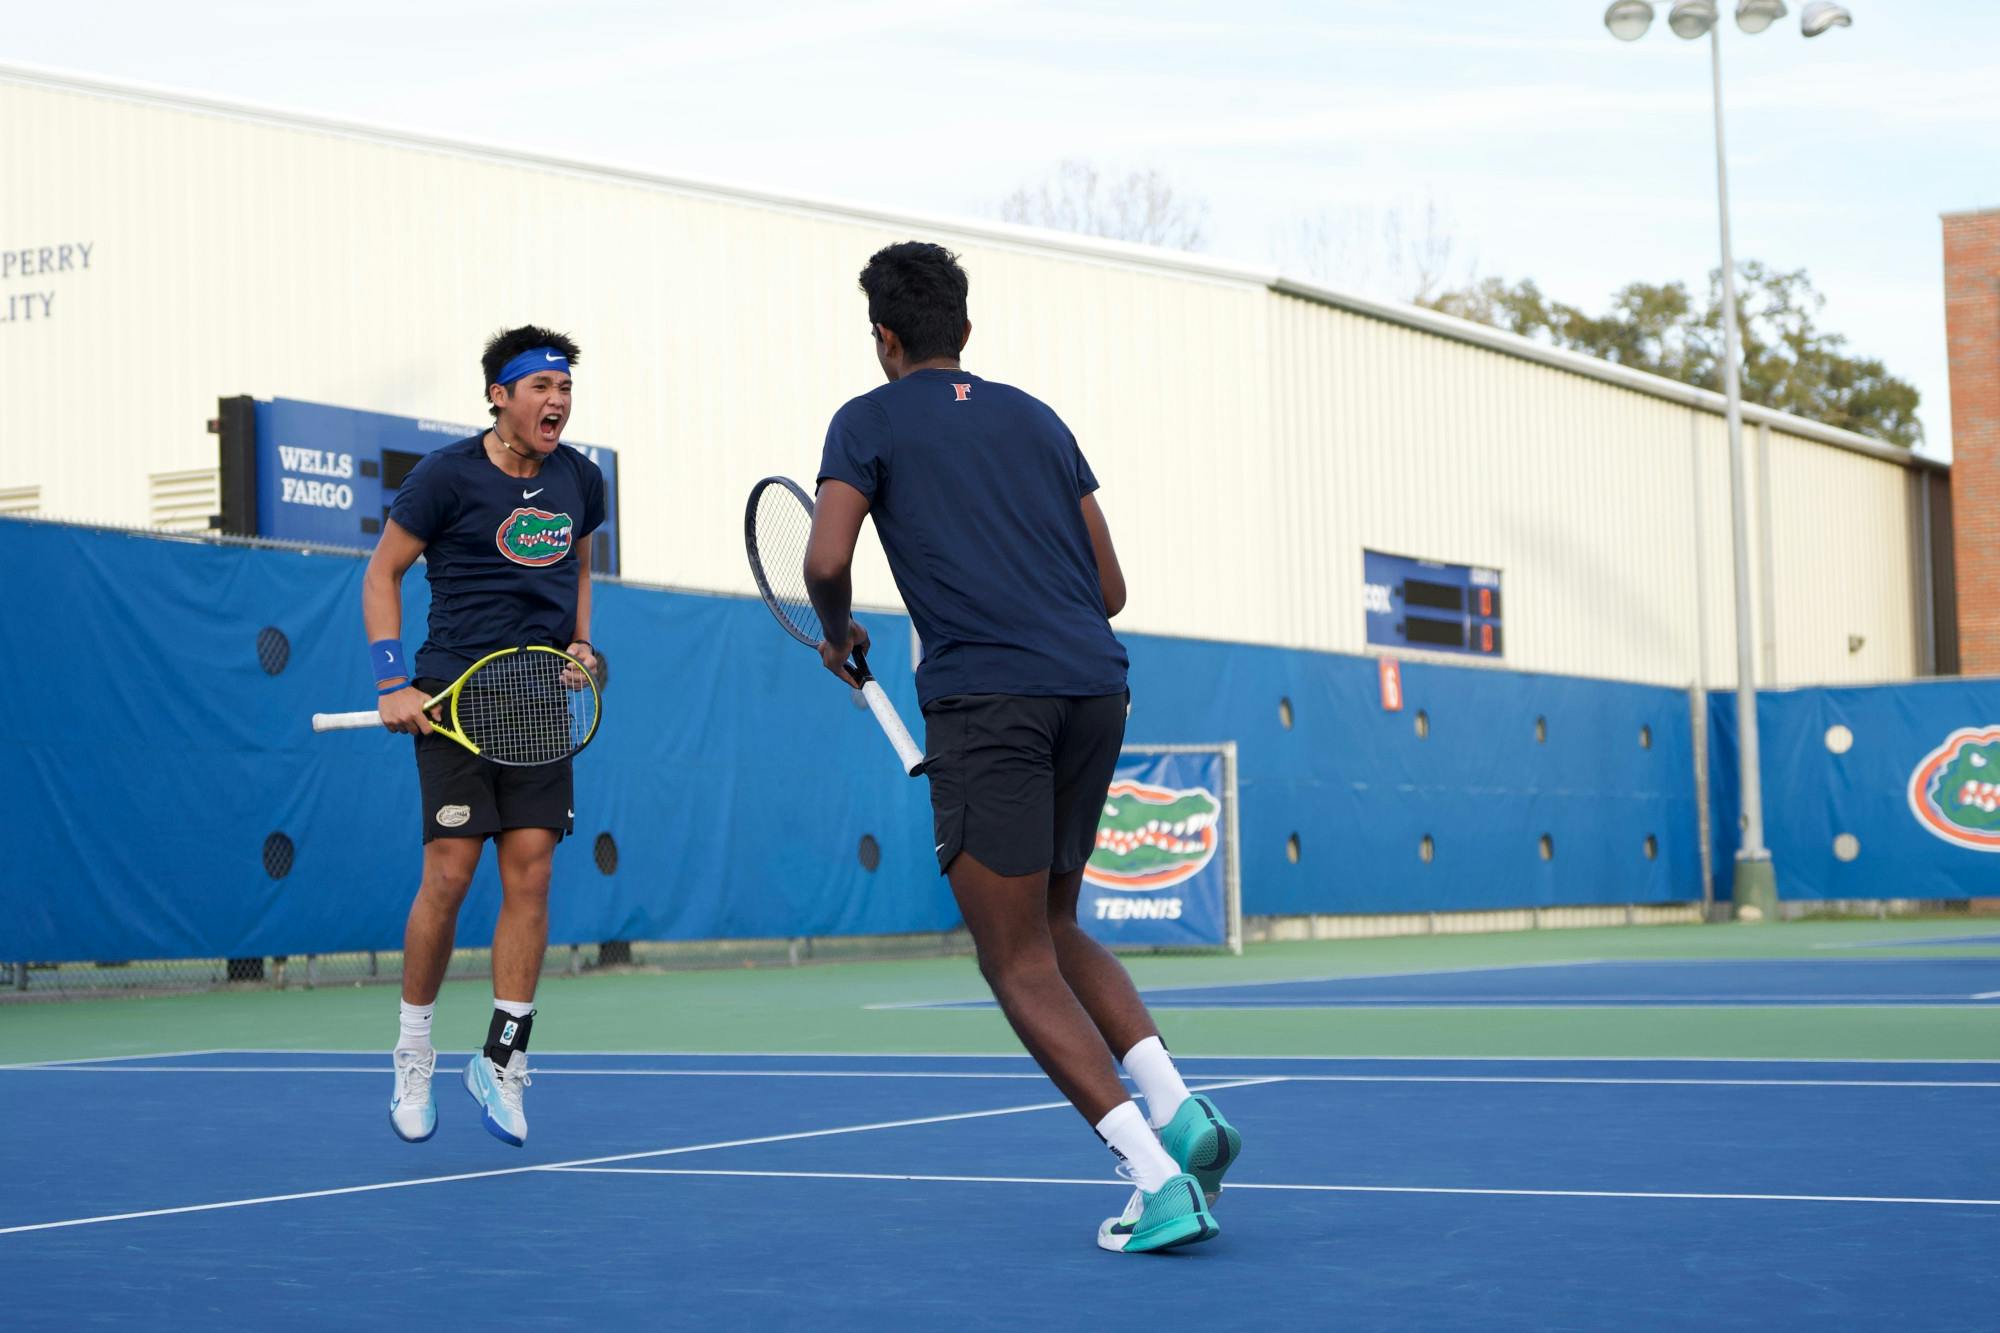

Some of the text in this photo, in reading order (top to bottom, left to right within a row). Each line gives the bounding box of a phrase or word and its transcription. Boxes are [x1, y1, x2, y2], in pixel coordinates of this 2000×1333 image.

[1, 241, 95, 278] PERRY
[950, 383, 972, 401] F
[278, 445, 353, 479] WELLS
[281, 477, 353, 510] FARGO
[1095, 898, 1182, 920] TENNIS
